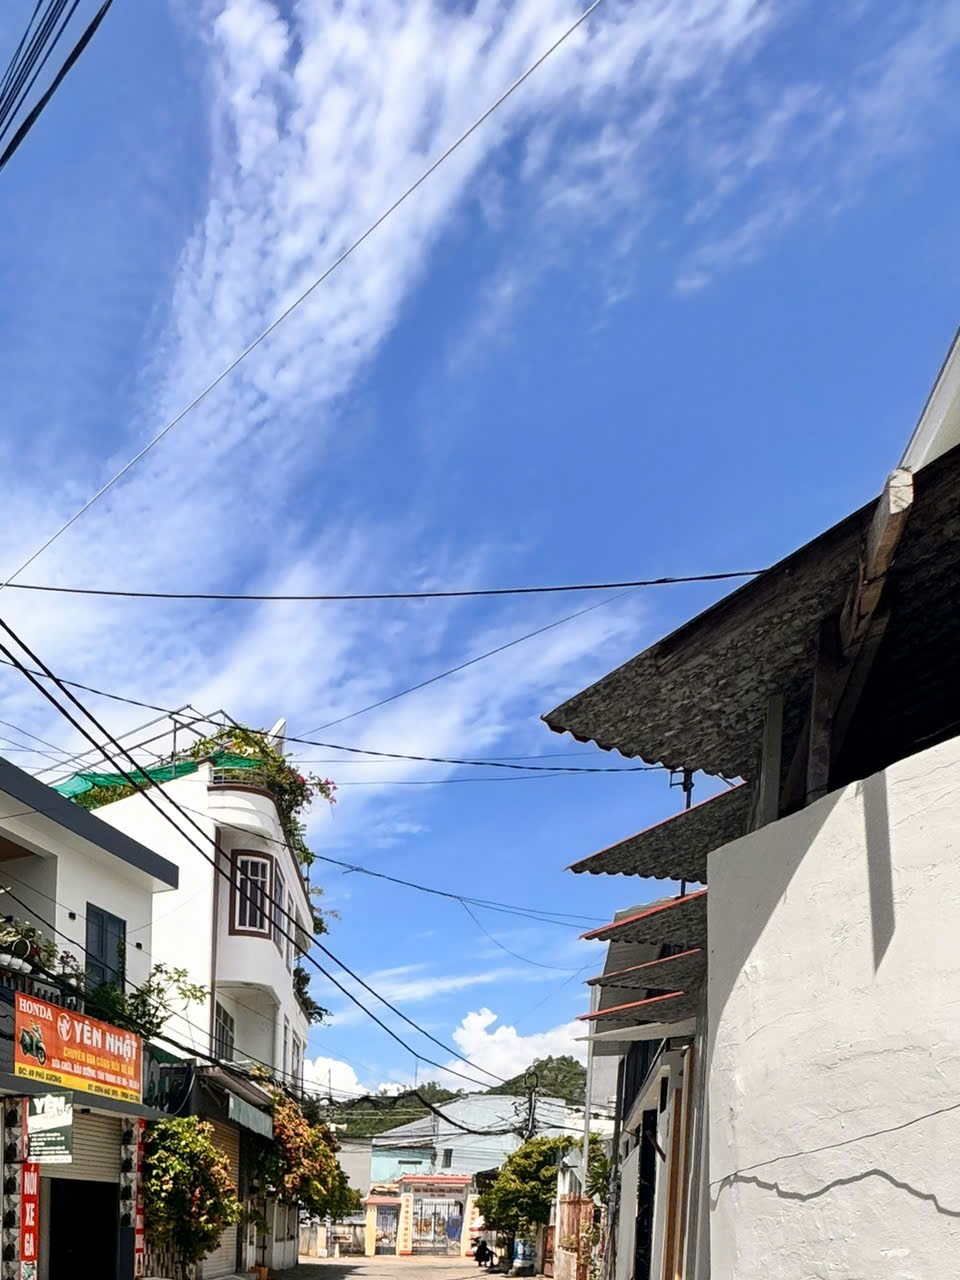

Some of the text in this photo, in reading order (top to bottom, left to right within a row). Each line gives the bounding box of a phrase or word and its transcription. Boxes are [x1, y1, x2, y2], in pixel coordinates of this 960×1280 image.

[19, 997, 53, 1021] HONDA
[73, 1020, 137, 1063] YÊN NHẬT
[24, 1202, 36, 1227] XE
[24, 1232, 35, 1257] GA
